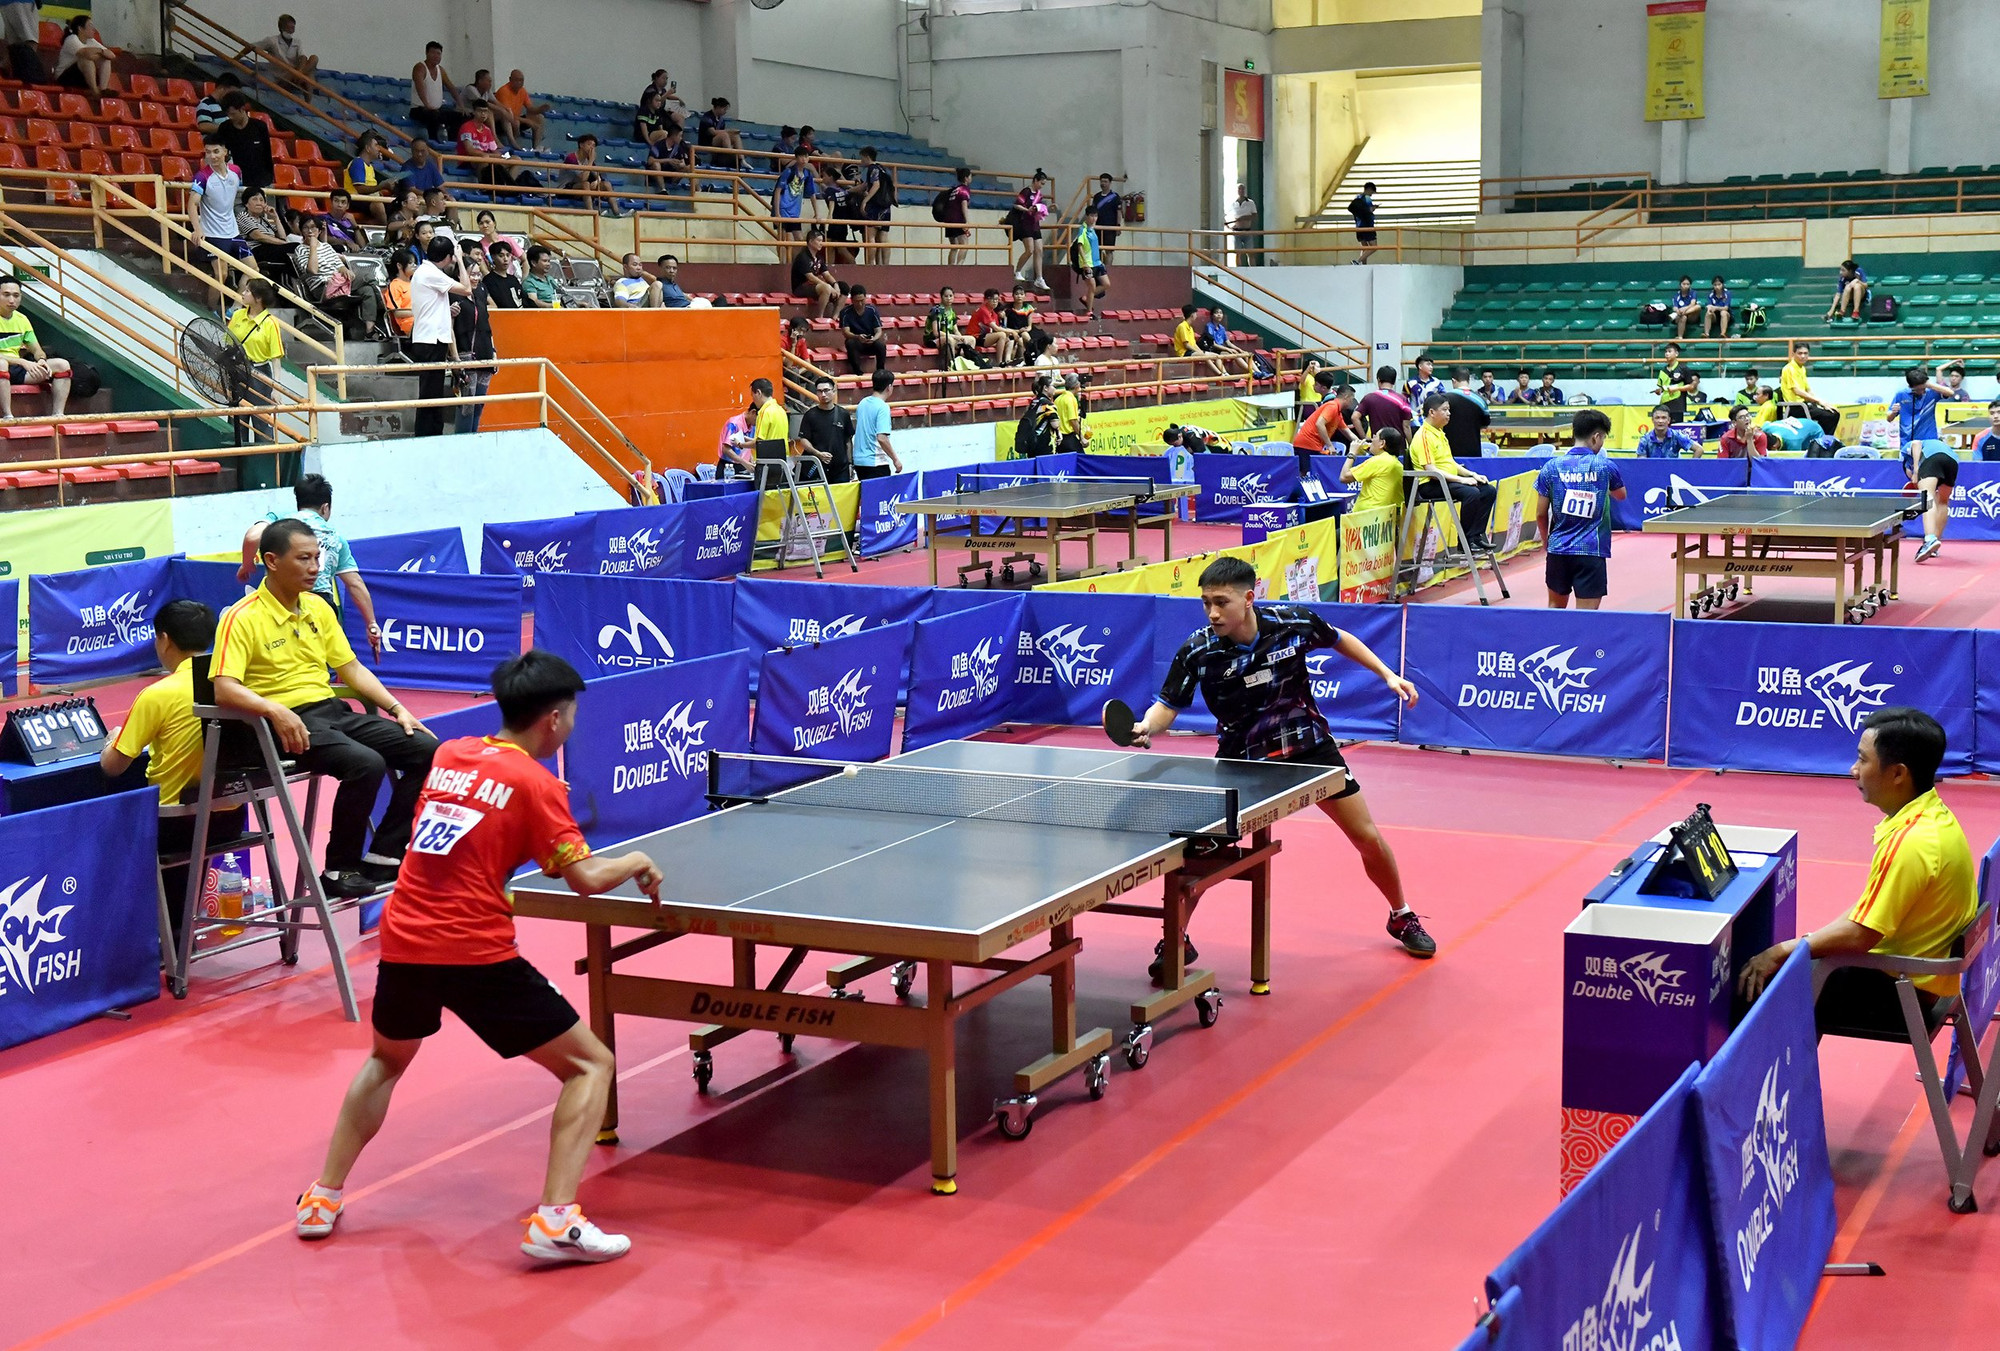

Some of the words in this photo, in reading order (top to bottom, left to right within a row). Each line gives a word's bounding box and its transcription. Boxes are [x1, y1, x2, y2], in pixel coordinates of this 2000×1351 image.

[1090, 433, 1106, 452] GIẢI
[1119, 434, 1137, 452] ĐỊCH
[1584, 471, 1597, 482] NAI
[1214, 493, 1247, 504] DOUBLE
[1567, 498, 1593, 517] 011
[964, 539, 996, 548] DOUBLE
[998, 540, 1016, 548] FISH
[1362, 516, 1380, 549] PHÚ
[696, 545, 723, 561] DOUBLE
[729, 541, 743, 554] FISH
[600, 558, 635, 575] DOUBLE
[644, 556, 663, 570] FISH
[1345, 560, 1357, 577] Cho
[1724, 562, 1767, 572] DOUBLE
[1769, 564, 1793, 573] FISH
[67, 632, 116, 655] DOUBLE
[129, 624, 157, 643] FISH
[405, 624, 484, 653] ENLIO
[1268, 647, 1294, 662] TAKE
[1477, 651, 1516, 678] 双魚
[1074, 668, 1114, 685] FISH
[1309, 680, 1341, 699] ISH
[1757, 666, 1802, 695] 双魚
[937, 685, 976, 712] DOUBLE
[981, 675, 999, 698] FISH
[1458, 684, 1537, 710] DOUBLE
[1561, 693, 1607, 713] FISH
[22, 718, 52, 747] 15
[70, 709, 99, 738] 16
[1735, 701, 1825, 729] DOUBLE
[793, 721, 840, 751] DOUBLE
[849, 709, 874, 733] FISH
[613, 759, 670, 794] DOUBLE
[686, 750, 709, 775] FIS
[426, 766, 479, 801] NGHỆ
[473, 778, 514, 810] AN
[1315, 786, 1327, 801] 235
[414, 818, 463, 851] 185
[1695, 846, 1714, 882] 4
[1708, 831, 1730, 869] 10
[1105, 858, 1166, 901] MOFIT
[35, 948, 81, 986] FISH
[1584, 955, 1618, 978] 双魚
[1572, 980, 1633, 1001] Double
[1659, 991, 1696, 1007] FISH
[690, 991, 780, 1022] DOUBLE
[785, 1006, 836, 1026] FISH
[1737, 1189, 1774, 1293] DOUBLE
